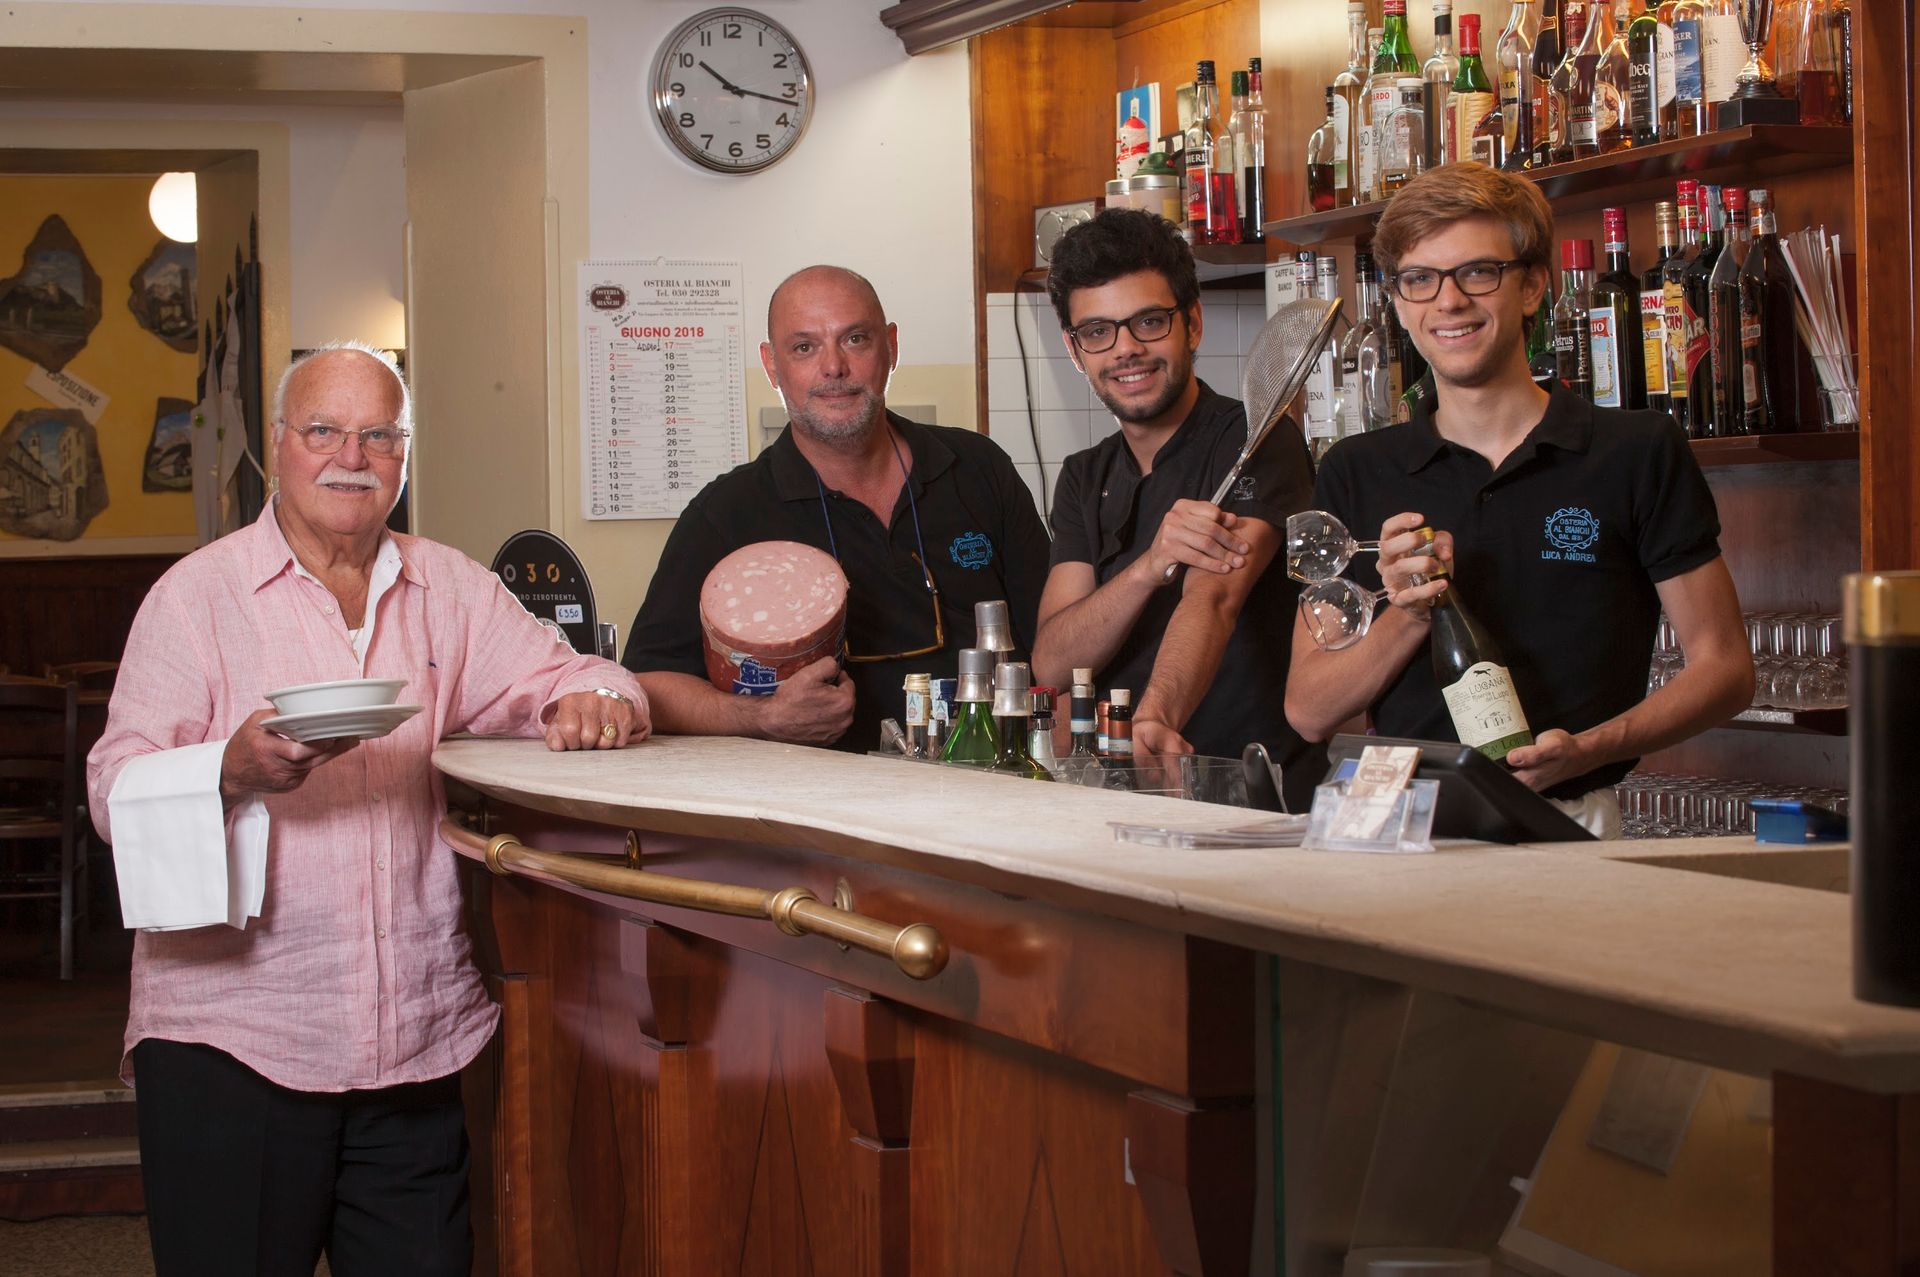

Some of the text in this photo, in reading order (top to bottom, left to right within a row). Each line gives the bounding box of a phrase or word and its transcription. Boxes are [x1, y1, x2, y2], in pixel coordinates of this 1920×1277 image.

[700, 31, 711, 46] 11
[724, 24, 742, 38] 12
[758, 32, 762, 47] 1
[679, 53, 694, 68] 10
[773, 54, 788, 68] 2
[670, 82, 685, 98] 9
[782, 83, 797, 98] 3
[679, 112, 695, 128] 8
[775, 112, 789, 128] 4
[700, 134, 714, 150] 7
[756, 134, 771, 149] 5
[728, 142, 743, 157] 6
[621, 327, 704, 338] GIUGNO 2018
[1565, 526, 1589, 534] BIANCHI
[1542, 550, 1596, 562] LUCA ANDREA
